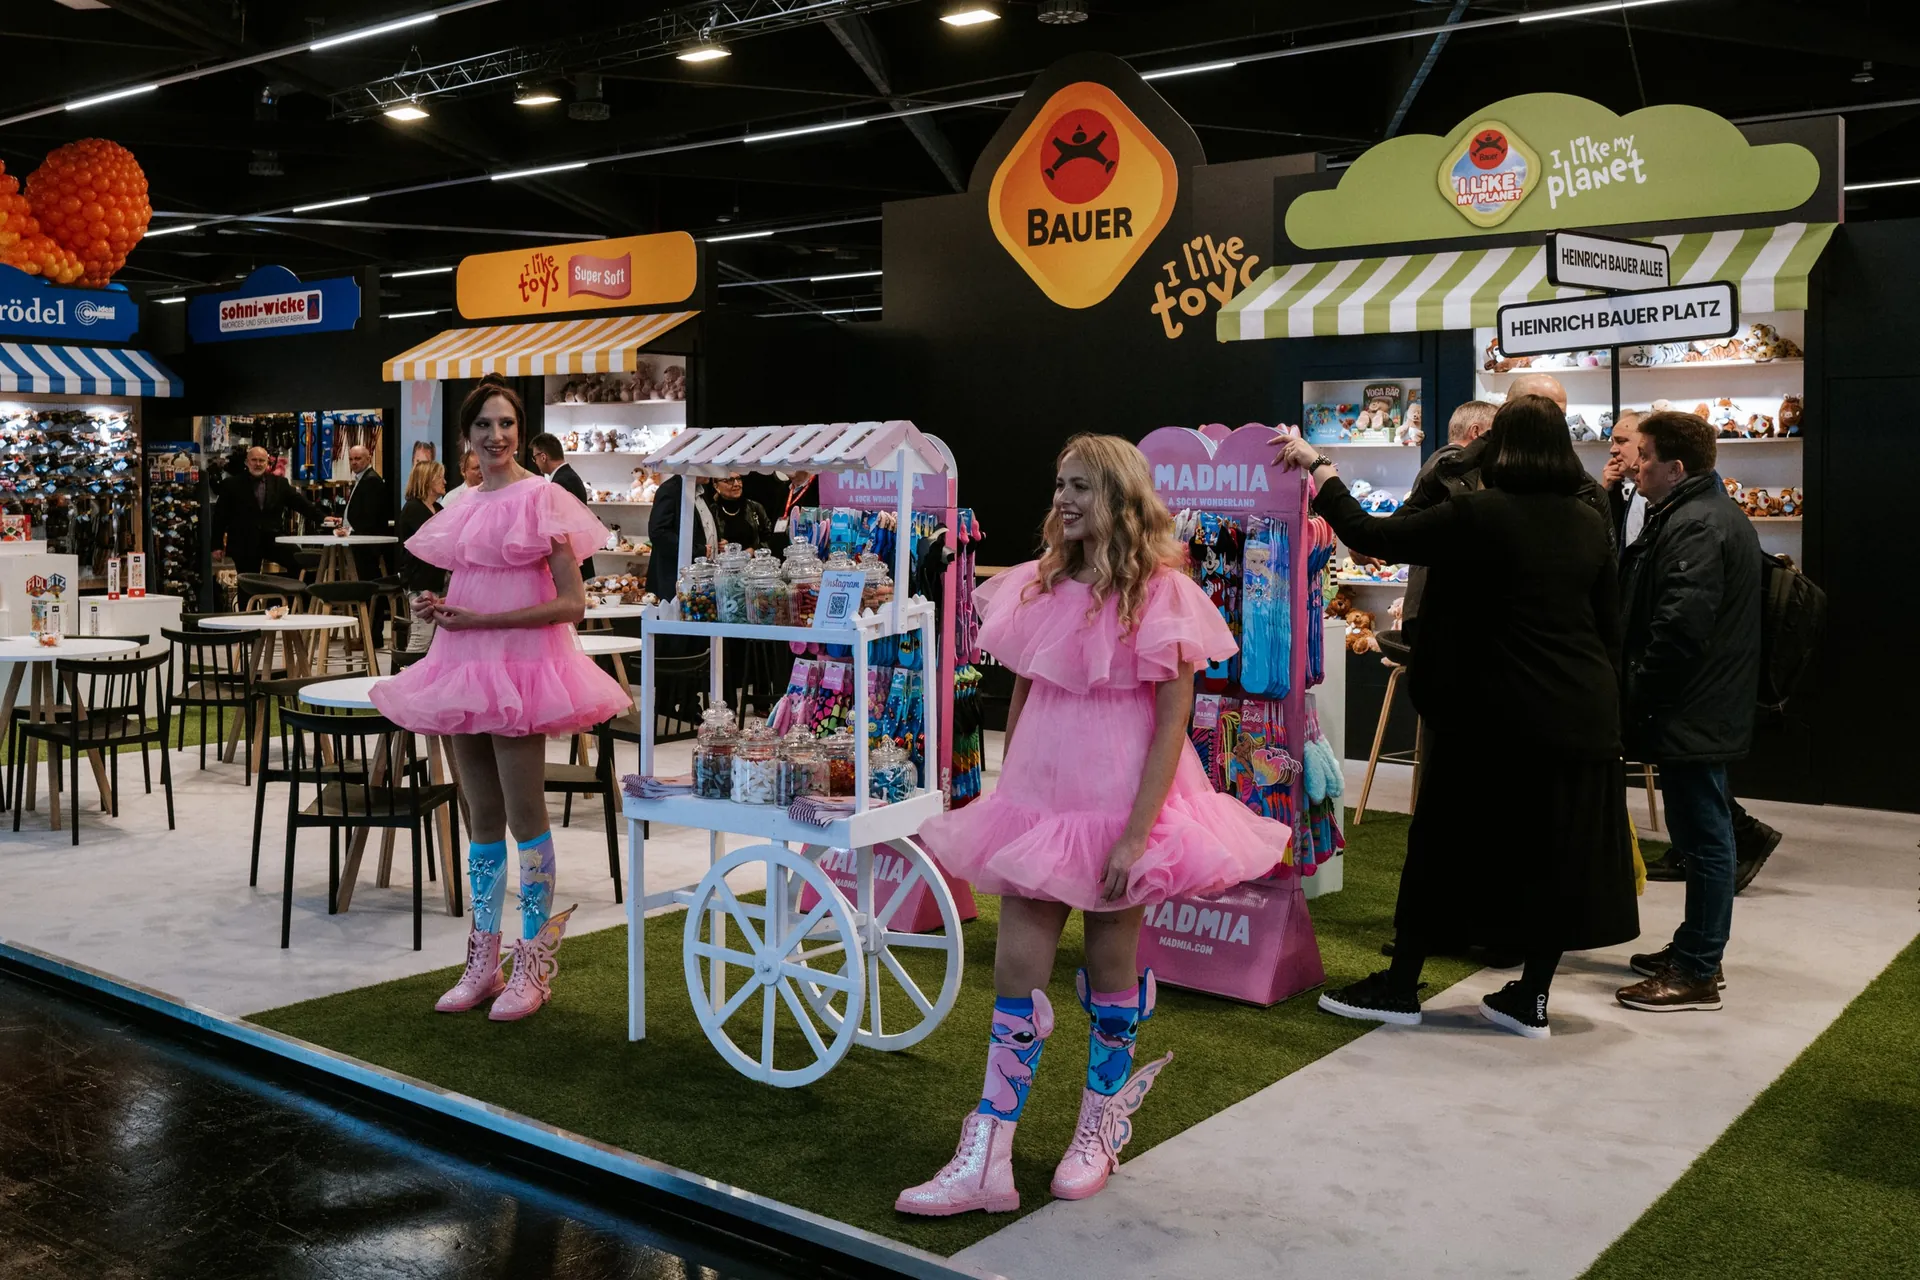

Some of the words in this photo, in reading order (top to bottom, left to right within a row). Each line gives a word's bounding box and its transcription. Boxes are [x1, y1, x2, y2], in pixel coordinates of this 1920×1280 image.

[1480, 152, 1498, 161] Bauer
[1550, 150, 1562, 169] I
[1570, 135, 1611, 165] like
[1457, 195, 1475, 205] MY
[1478, 189, 1523, 203] PLANET
[1458, 177, 1468, 195] I
[1027, 206, 1133, 247] BAUER
[523, 263, 530, 277] I
[531, 252, 554, 275] like
[1162, 260, 1181, 287] I
[1182, 234, 1244, 280] like
[1561, 247, 1607, 270] HEINRICH
[1608, 255, 1638, 276] BAUER
[1639, 258, 1664, 278] ALLEE
[518, 265, 560, 308] toys
[574, 265, 601, 286] Super
[603, 268, 625, 285] Soft
[0, 297, 66, 325] rödel
[221, 297, 305, 321] sohni-wicke
[1511, 313, 1595, 338] HEINRICH
[1598, 305, 1659, 329] BAUER
[1661, 299, 1721, 322] PLATZ
[1365, 387, 1384, 397] YOGA
[1385, 386, 1400, 398] BÄR
[838, 469, 925, 490] MADMA
[1154, 463, 1270, 492] MADMIA
[872, 495, 914, 504] WONDER
[1168, 497, 1175, 506] A
[1176, 497, 1198, 506] SOCK
[1200, 497, 1256, 507] WONDERLAND
[1242, 709, 1263, 723] Barbie
[1143, 900, 1251, 946] MADMIA
[1159, 936, 1214, 955] MADMIA.COM
[1536, 993, 1546, 1020] Chloé
